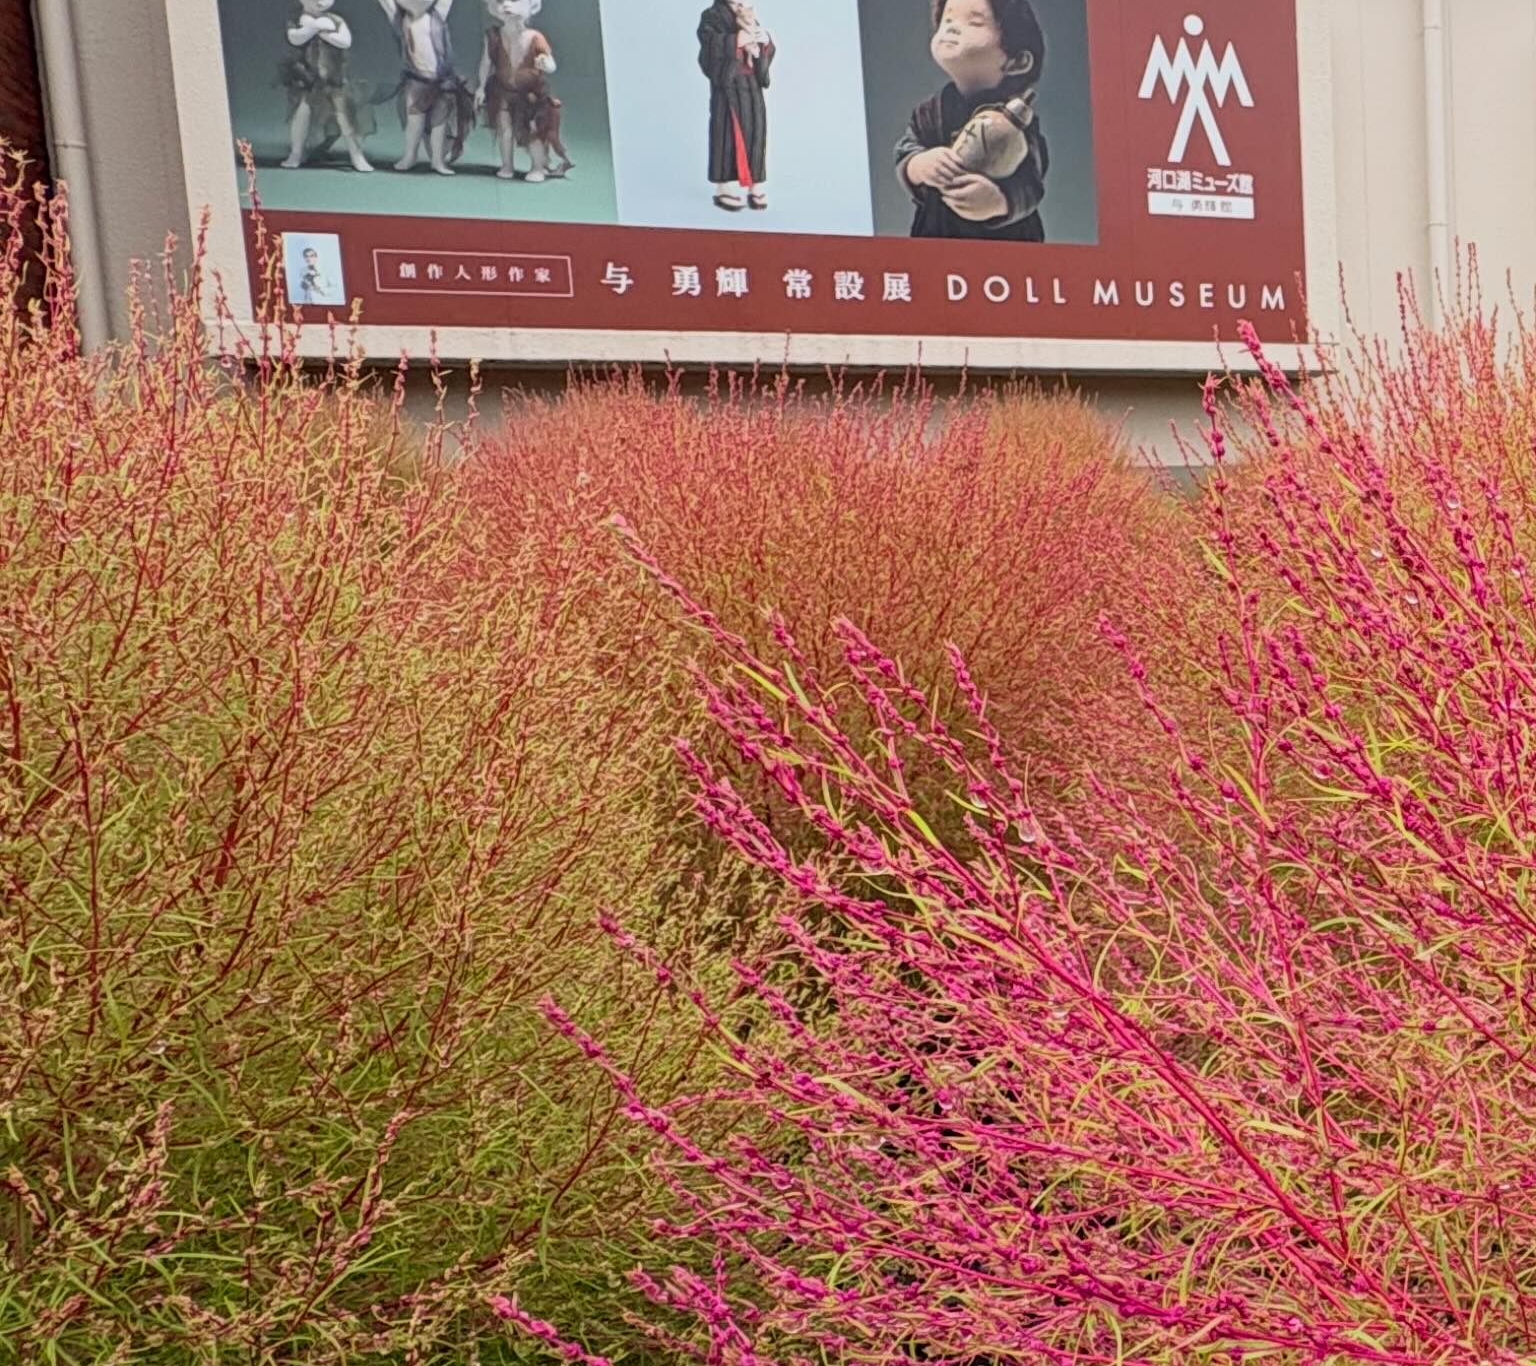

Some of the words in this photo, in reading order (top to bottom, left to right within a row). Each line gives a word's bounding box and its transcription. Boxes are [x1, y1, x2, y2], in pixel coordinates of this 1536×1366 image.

[1147, 168, 1254, 194] 河口湖ミューズ館
[399, 262, 551, 283] 創作人形作家
[600, 261, 634, 295] 与
[671, 265, 749, 298] 勇輝
[782, 268, 913, 302] 常設展
[946, 274, 1067, 304] DOLL
[1093, 278, 1286, 311] MUSEUM
